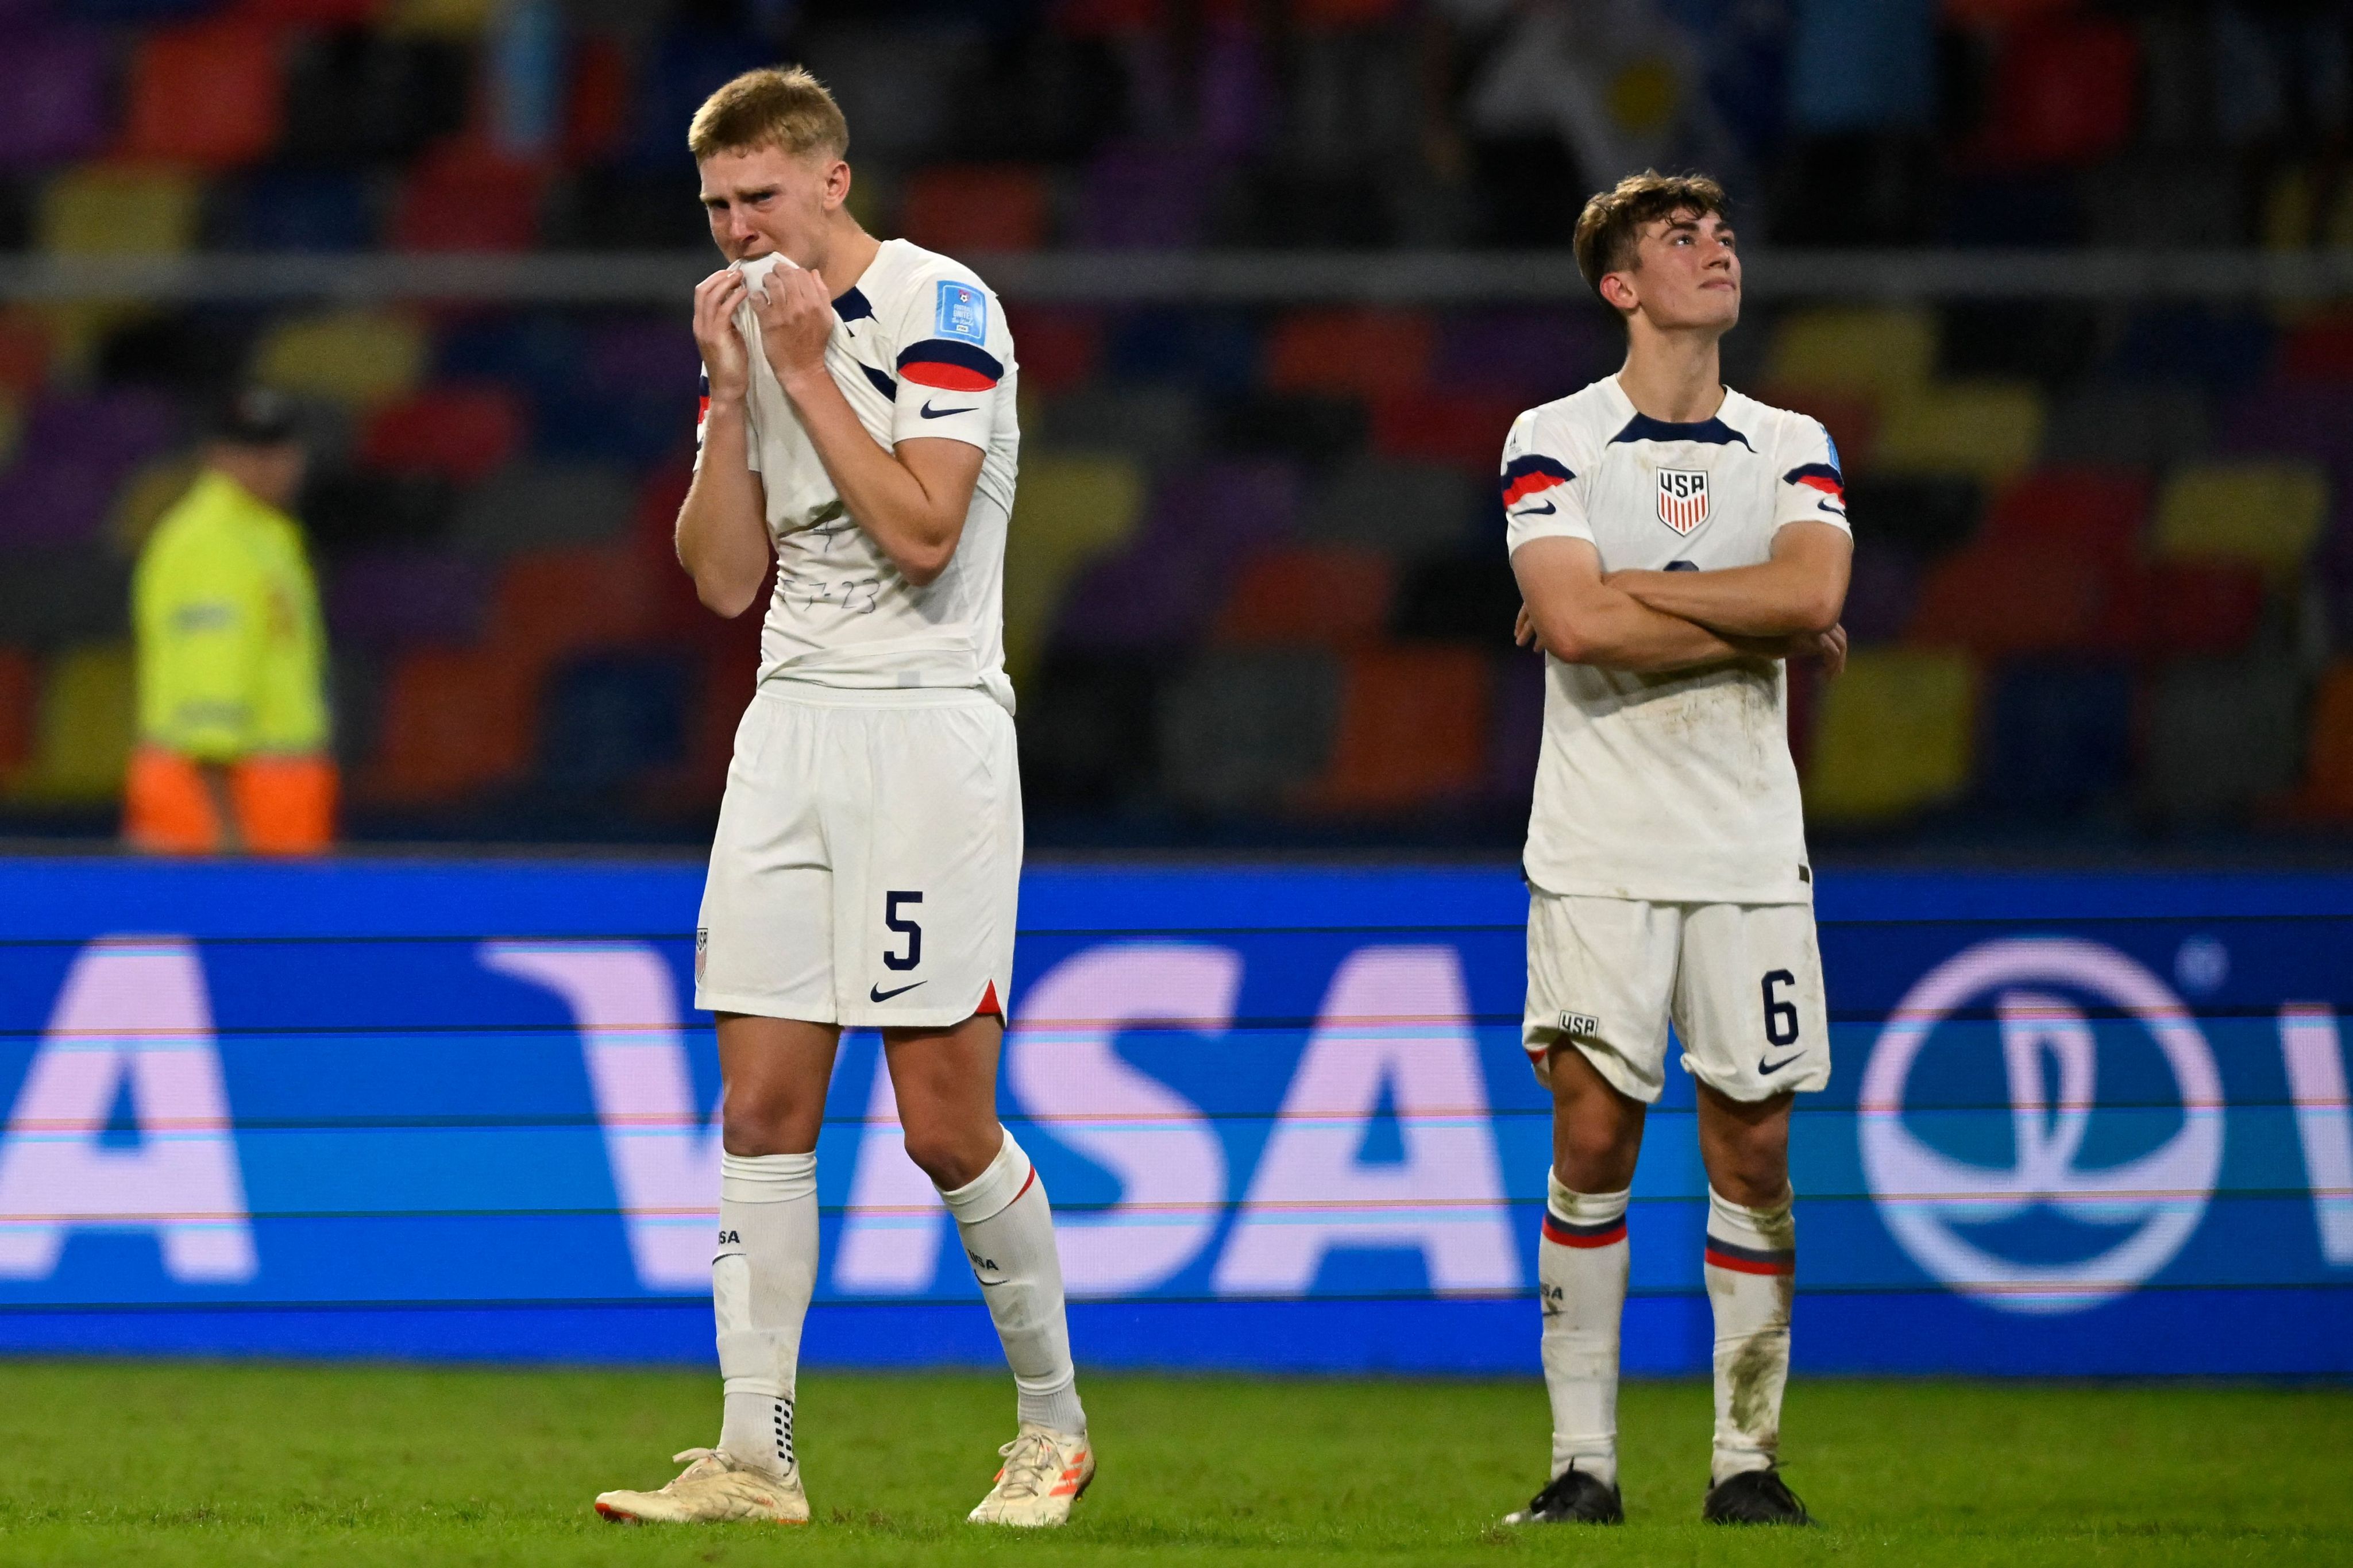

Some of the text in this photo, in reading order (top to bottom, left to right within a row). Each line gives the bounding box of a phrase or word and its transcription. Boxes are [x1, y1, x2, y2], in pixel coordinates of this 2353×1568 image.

[1660, 472, 1704, 499] USA
[884, 891, 923, 971] 5
[1761, 968, 1799, 1046] 6
[1562, 1014, 1595, 1034] USA
[719, 1230, 740, 1245] SA
[967, 1249, 999, 1270] USA
